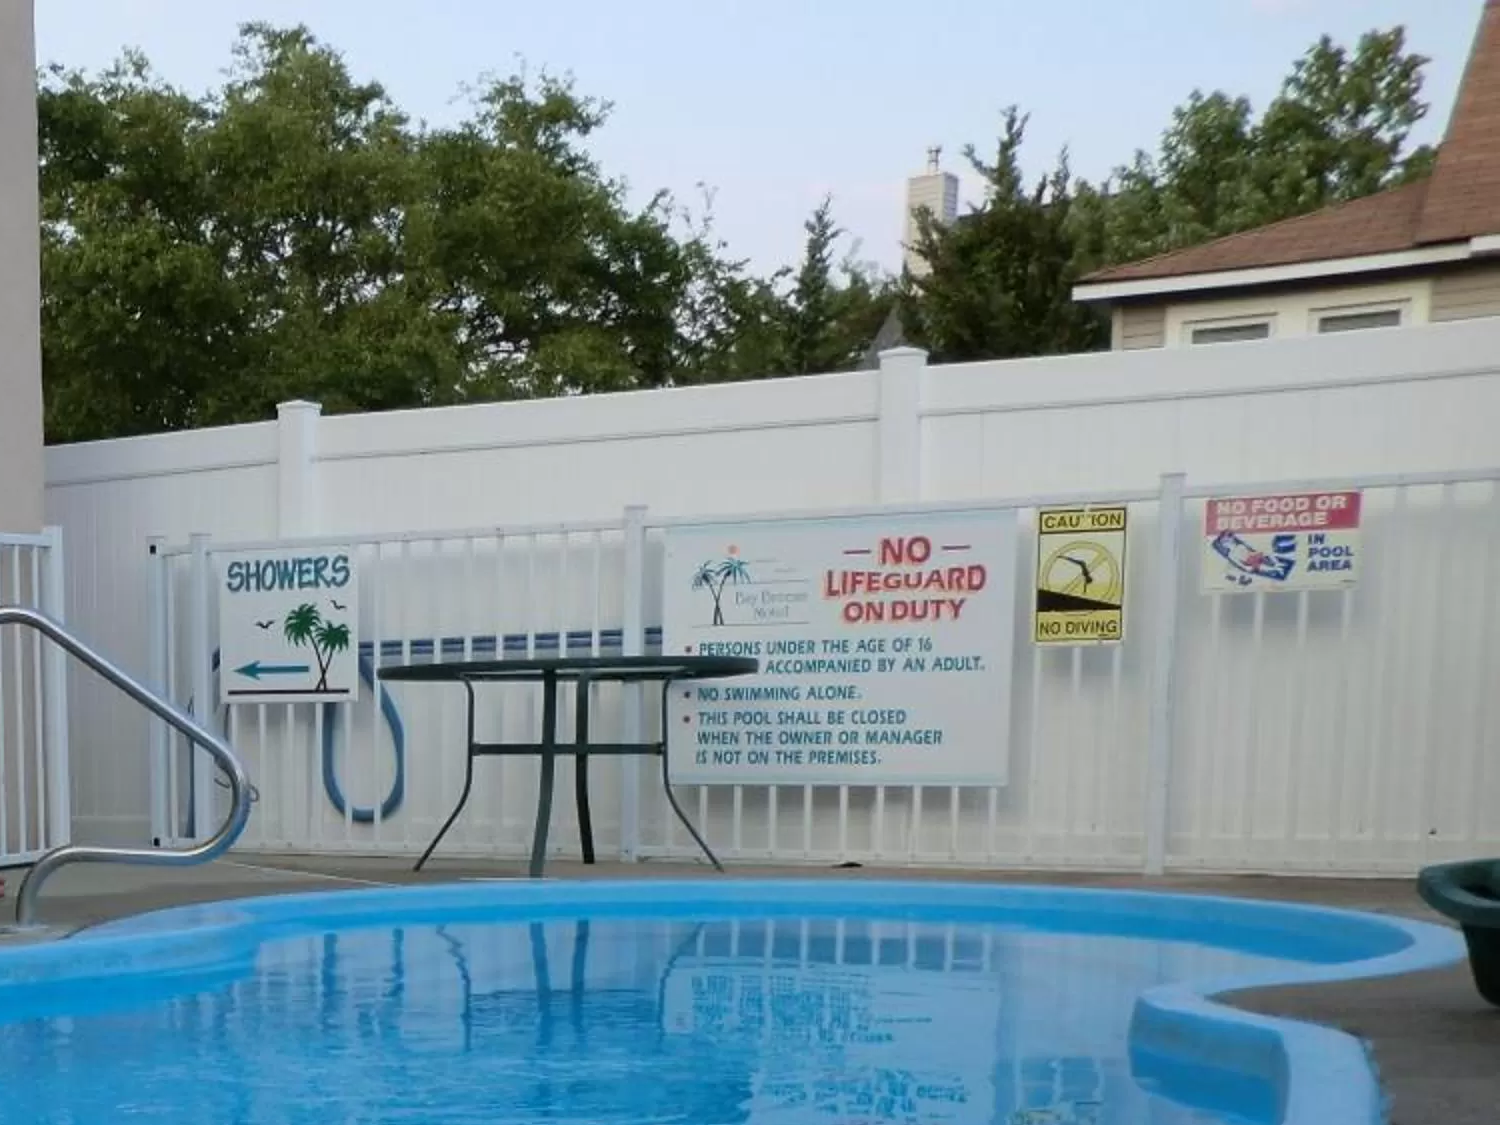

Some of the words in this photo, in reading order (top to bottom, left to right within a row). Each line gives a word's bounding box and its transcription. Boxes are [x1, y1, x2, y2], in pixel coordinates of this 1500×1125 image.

[1217, 500, 1245, 515] NO
[1251, 497, 1310, 513] FOOD
[1315, 495, 1348, 510] OR
[1043, 512, 1122, 529] CAUION
[1216, 511, 1329, 530] BEVERAGE
[1307, 533, 1326, 545] IN
[880, 536, 932, 565] NO
[1307, 545, 1354, 558] POOL
[226, 555, 351, 592] SHOWERS
[1307, 558, 1353, 573] AREA
[825, 564, 988, 598] LIFEGUARD
[843, 600, 885, 623] ON
[891, 597, 967, 621] DUTY
[1039, 620, 1061, 636] NO
[1065, 619, 1118, 634] DIVING
[699, 641, 762, 657] PERSONS
[766, 640, 816, 655] UNDER
[821, 639, 849, 654] THE
[855, 638, 886, 653] AGE
[891, 637, 913, 653] OF
[917, 636, 933, 652] 16
[763, 657, 872, 674] ACCOMPANIED
[877, 657, 897, 673] BY
[902, 656, 926, 673] AN
[931, 655, 986, 672] ADULT.
[697, 686, 719, 701] NO
[723, 686, 801, 701] SWIMMING
[805, 684, 863, 700] ALONE.
[697, 711, 729, 726] THIS
[733, 711, 773, 726] POOL
[776, 710, 822, 725] SHALL
[826, 710, 845, 725] BE
[850, 709, 908, 725] CLOSED
[696, 731, 740, 746] WHEN
[745, 731, 773, 745] THE
[778, 731, 833, 745] OWNER
[837, 730, 860, 745] OR
[864, 729, 944, 745] MANAGER
[694, 750, 707, 765] IS
[712, 750, 742, 765] NOT
[747, 750, 770, 765] ON
[774, 750, 804, 765] THE
[807, 749, 883, 765] PREMISES.
